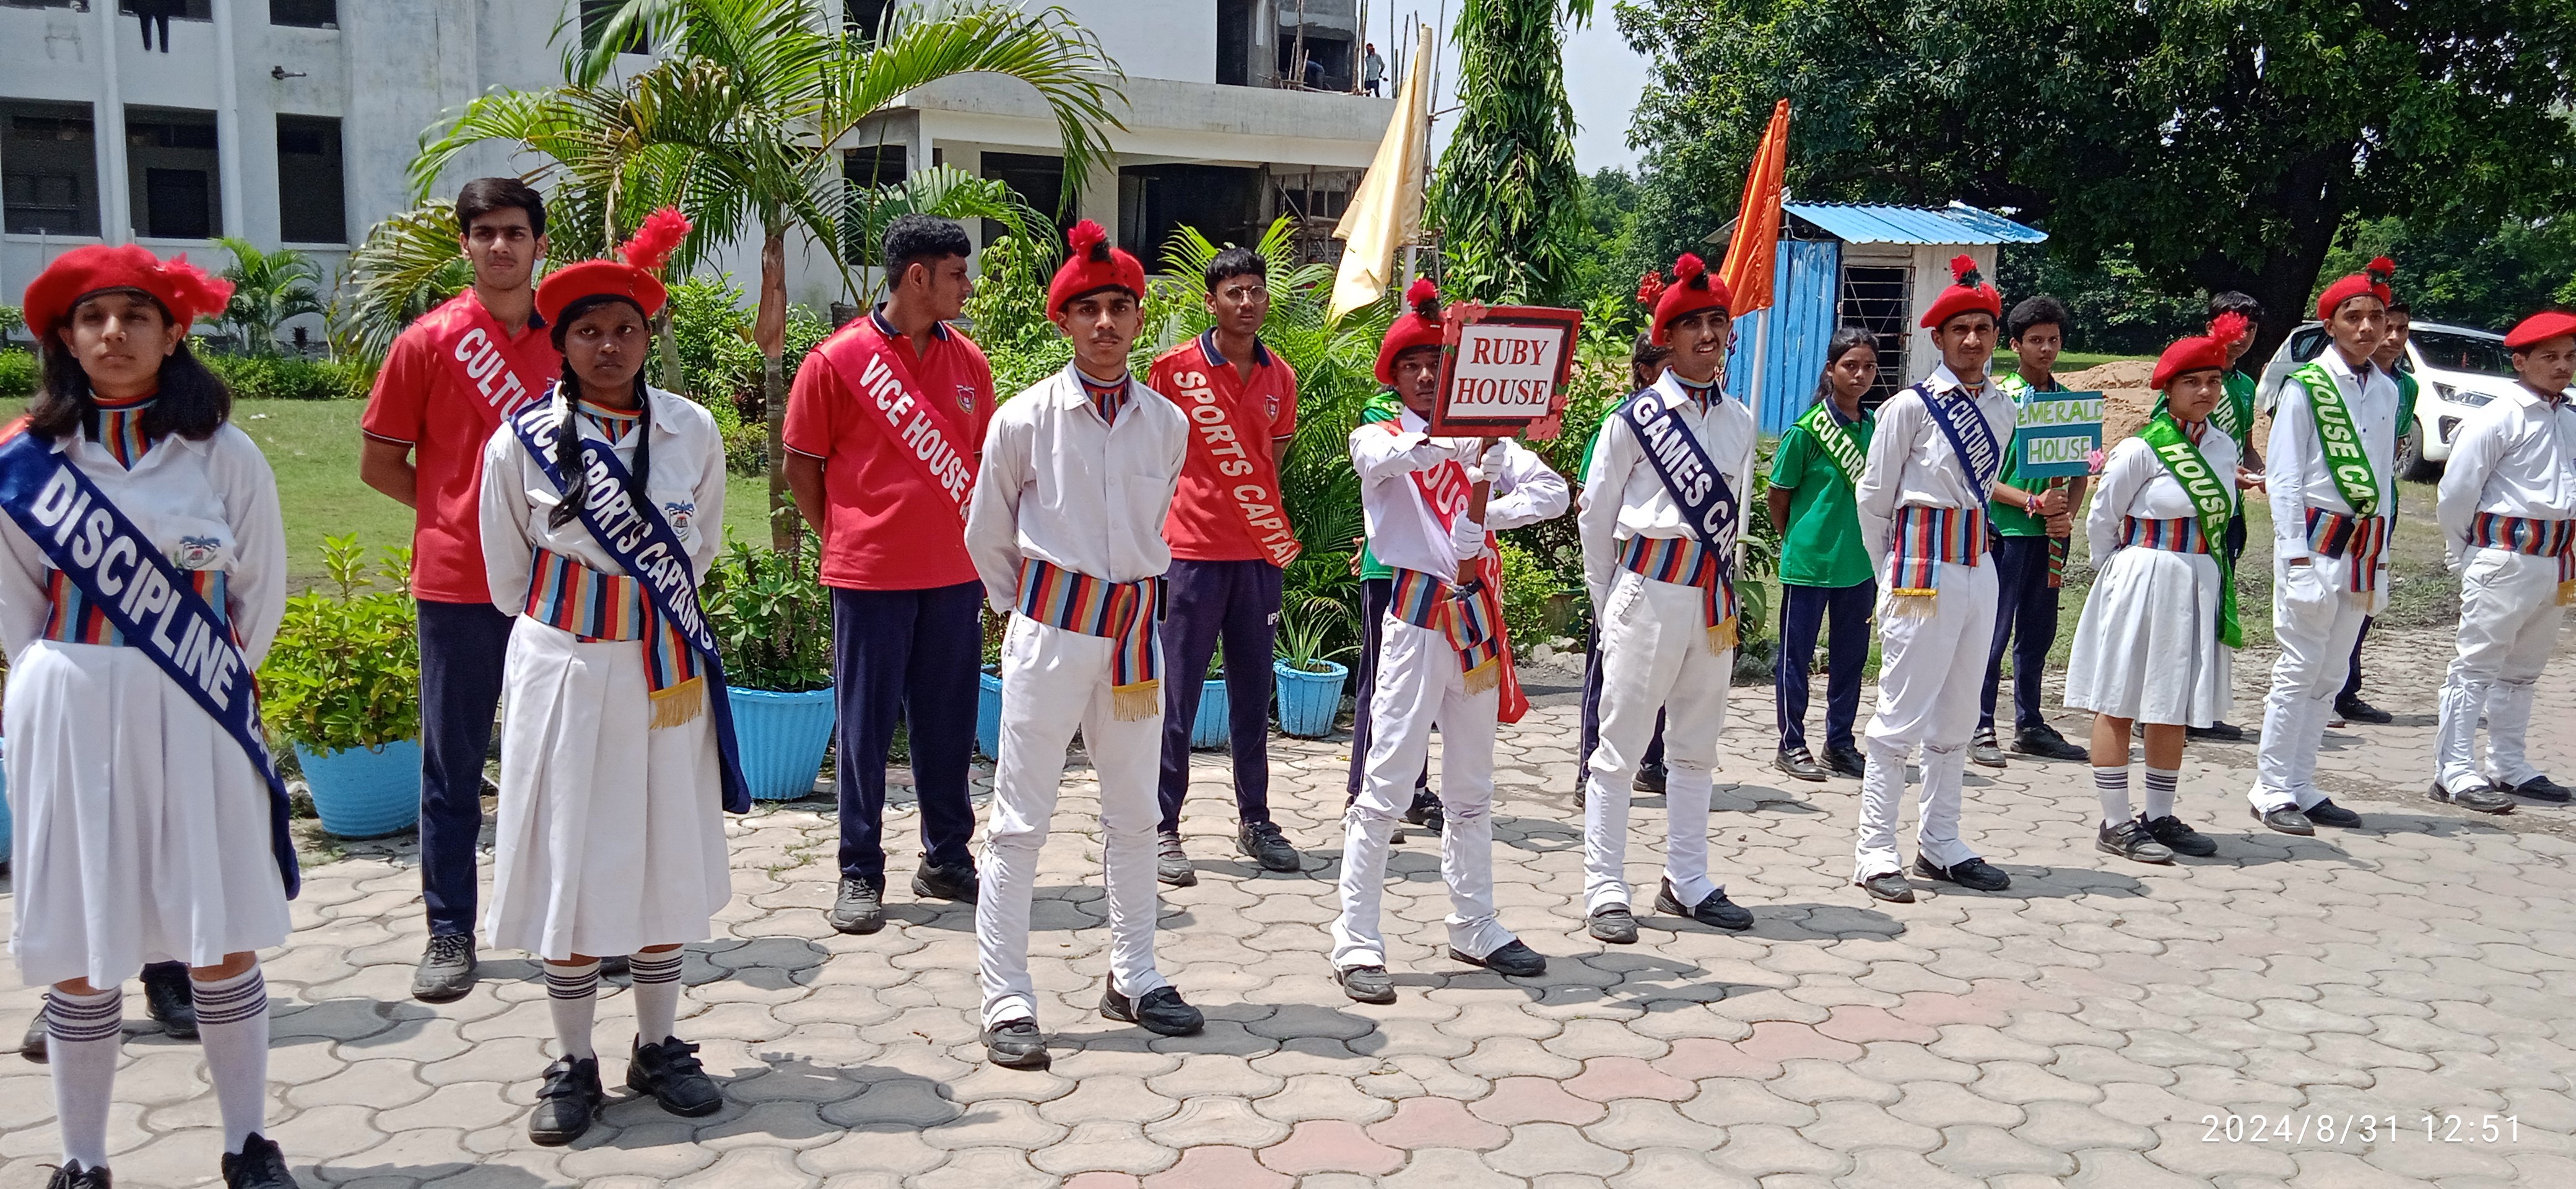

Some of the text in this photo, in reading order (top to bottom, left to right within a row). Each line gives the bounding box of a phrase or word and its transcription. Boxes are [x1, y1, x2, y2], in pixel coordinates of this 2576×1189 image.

[1453, 378, 1548, 405] HOUSE
[1470, 338, 1549, 365] RUBY
[859, 352, 971, 503] VICE HOUSE
[1173, 371, 1254, 477] SPORTS
[1632, 396, 1713, 507] GAMES
[1947, 400, 1995, 481] CULTURAL
[2017, 400, 2104, 425] EMERALD
[2029, 437, 2090, 463] HOUSE
[2296, 370, 2360, 458] HOUSE
[2157, 443, 2226, 529] HOUSE
[31, 464, 239, 712] DISCIPLINE
[635, 542, 698, 638] CAPTAIN
